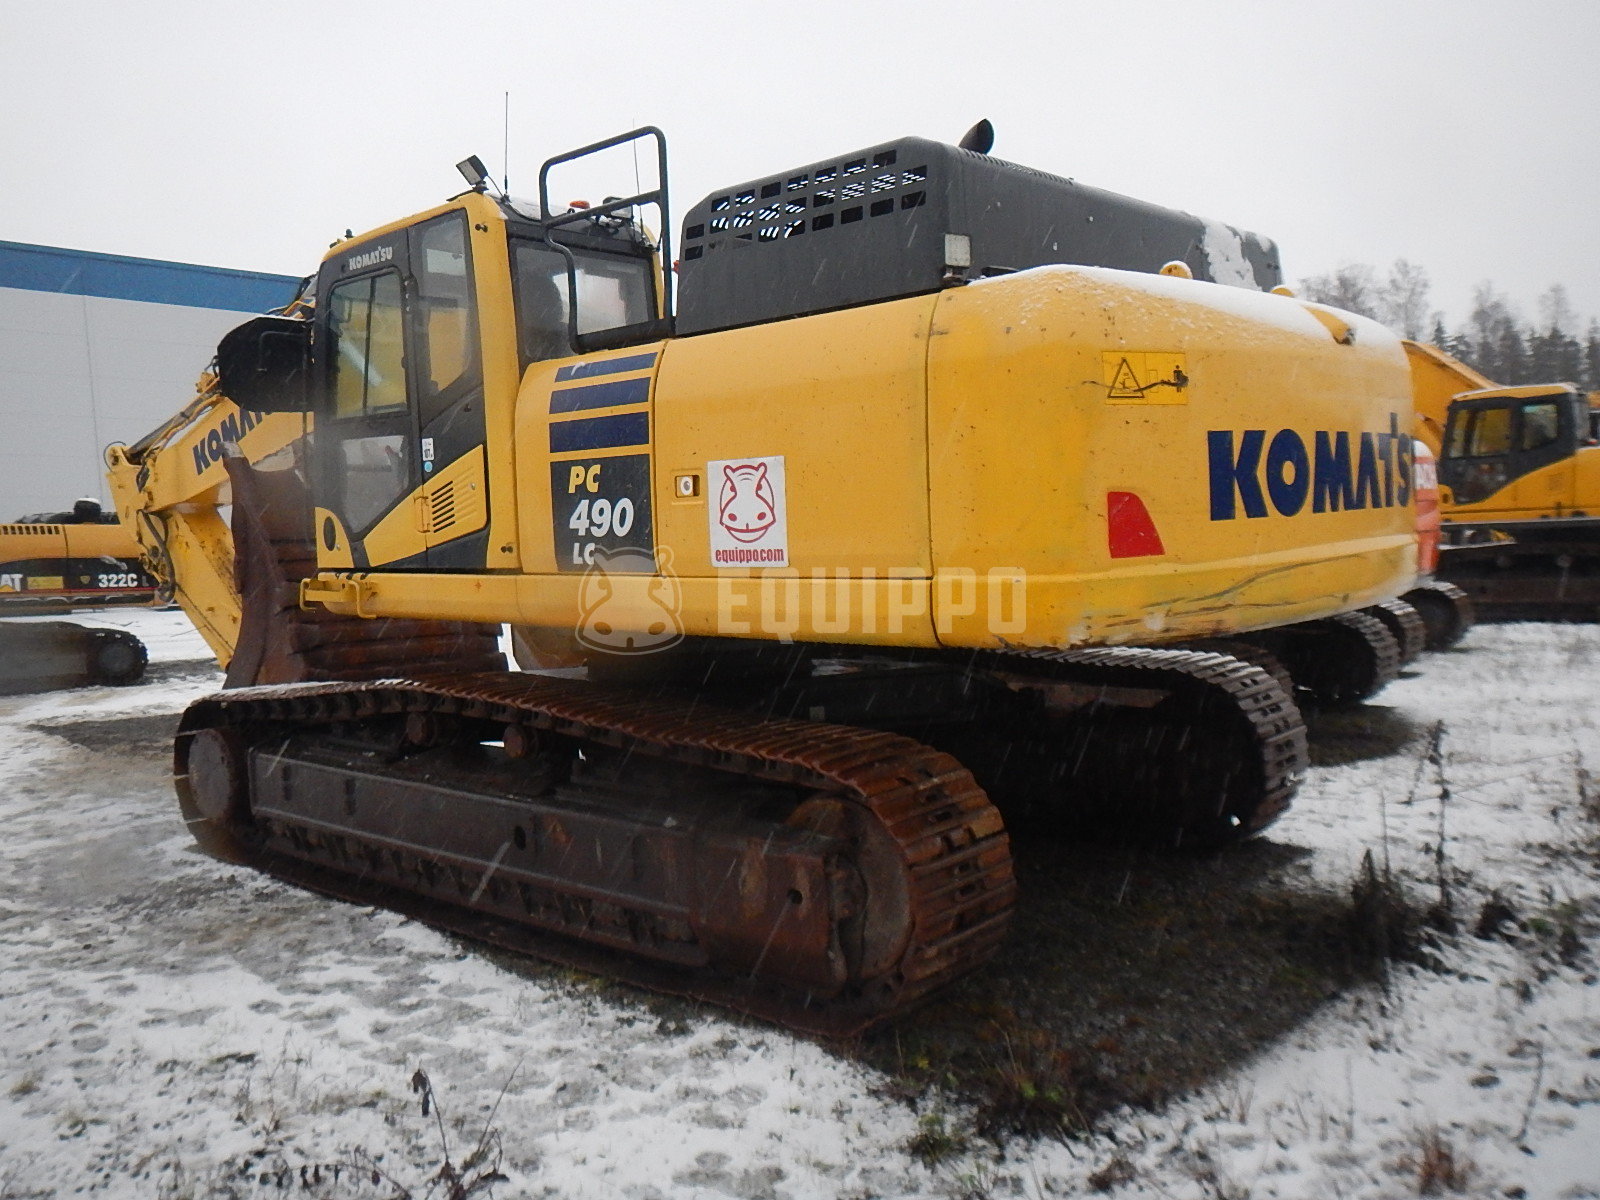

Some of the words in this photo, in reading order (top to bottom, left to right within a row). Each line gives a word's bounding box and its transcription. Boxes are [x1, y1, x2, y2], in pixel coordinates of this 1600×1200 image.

[349, 246, 393, 271] KOMATSU
[568, 464, 601, 493] PC
[1207, 412, 1415, 521] KOMATS
[569, 497, 634, 537] 490
[572, 542, 596, 565] LC
[715, 547, 785, 564] equippo.com
[0, 573, 23, 592] AT
[98, 573, 138, 588] 322C
